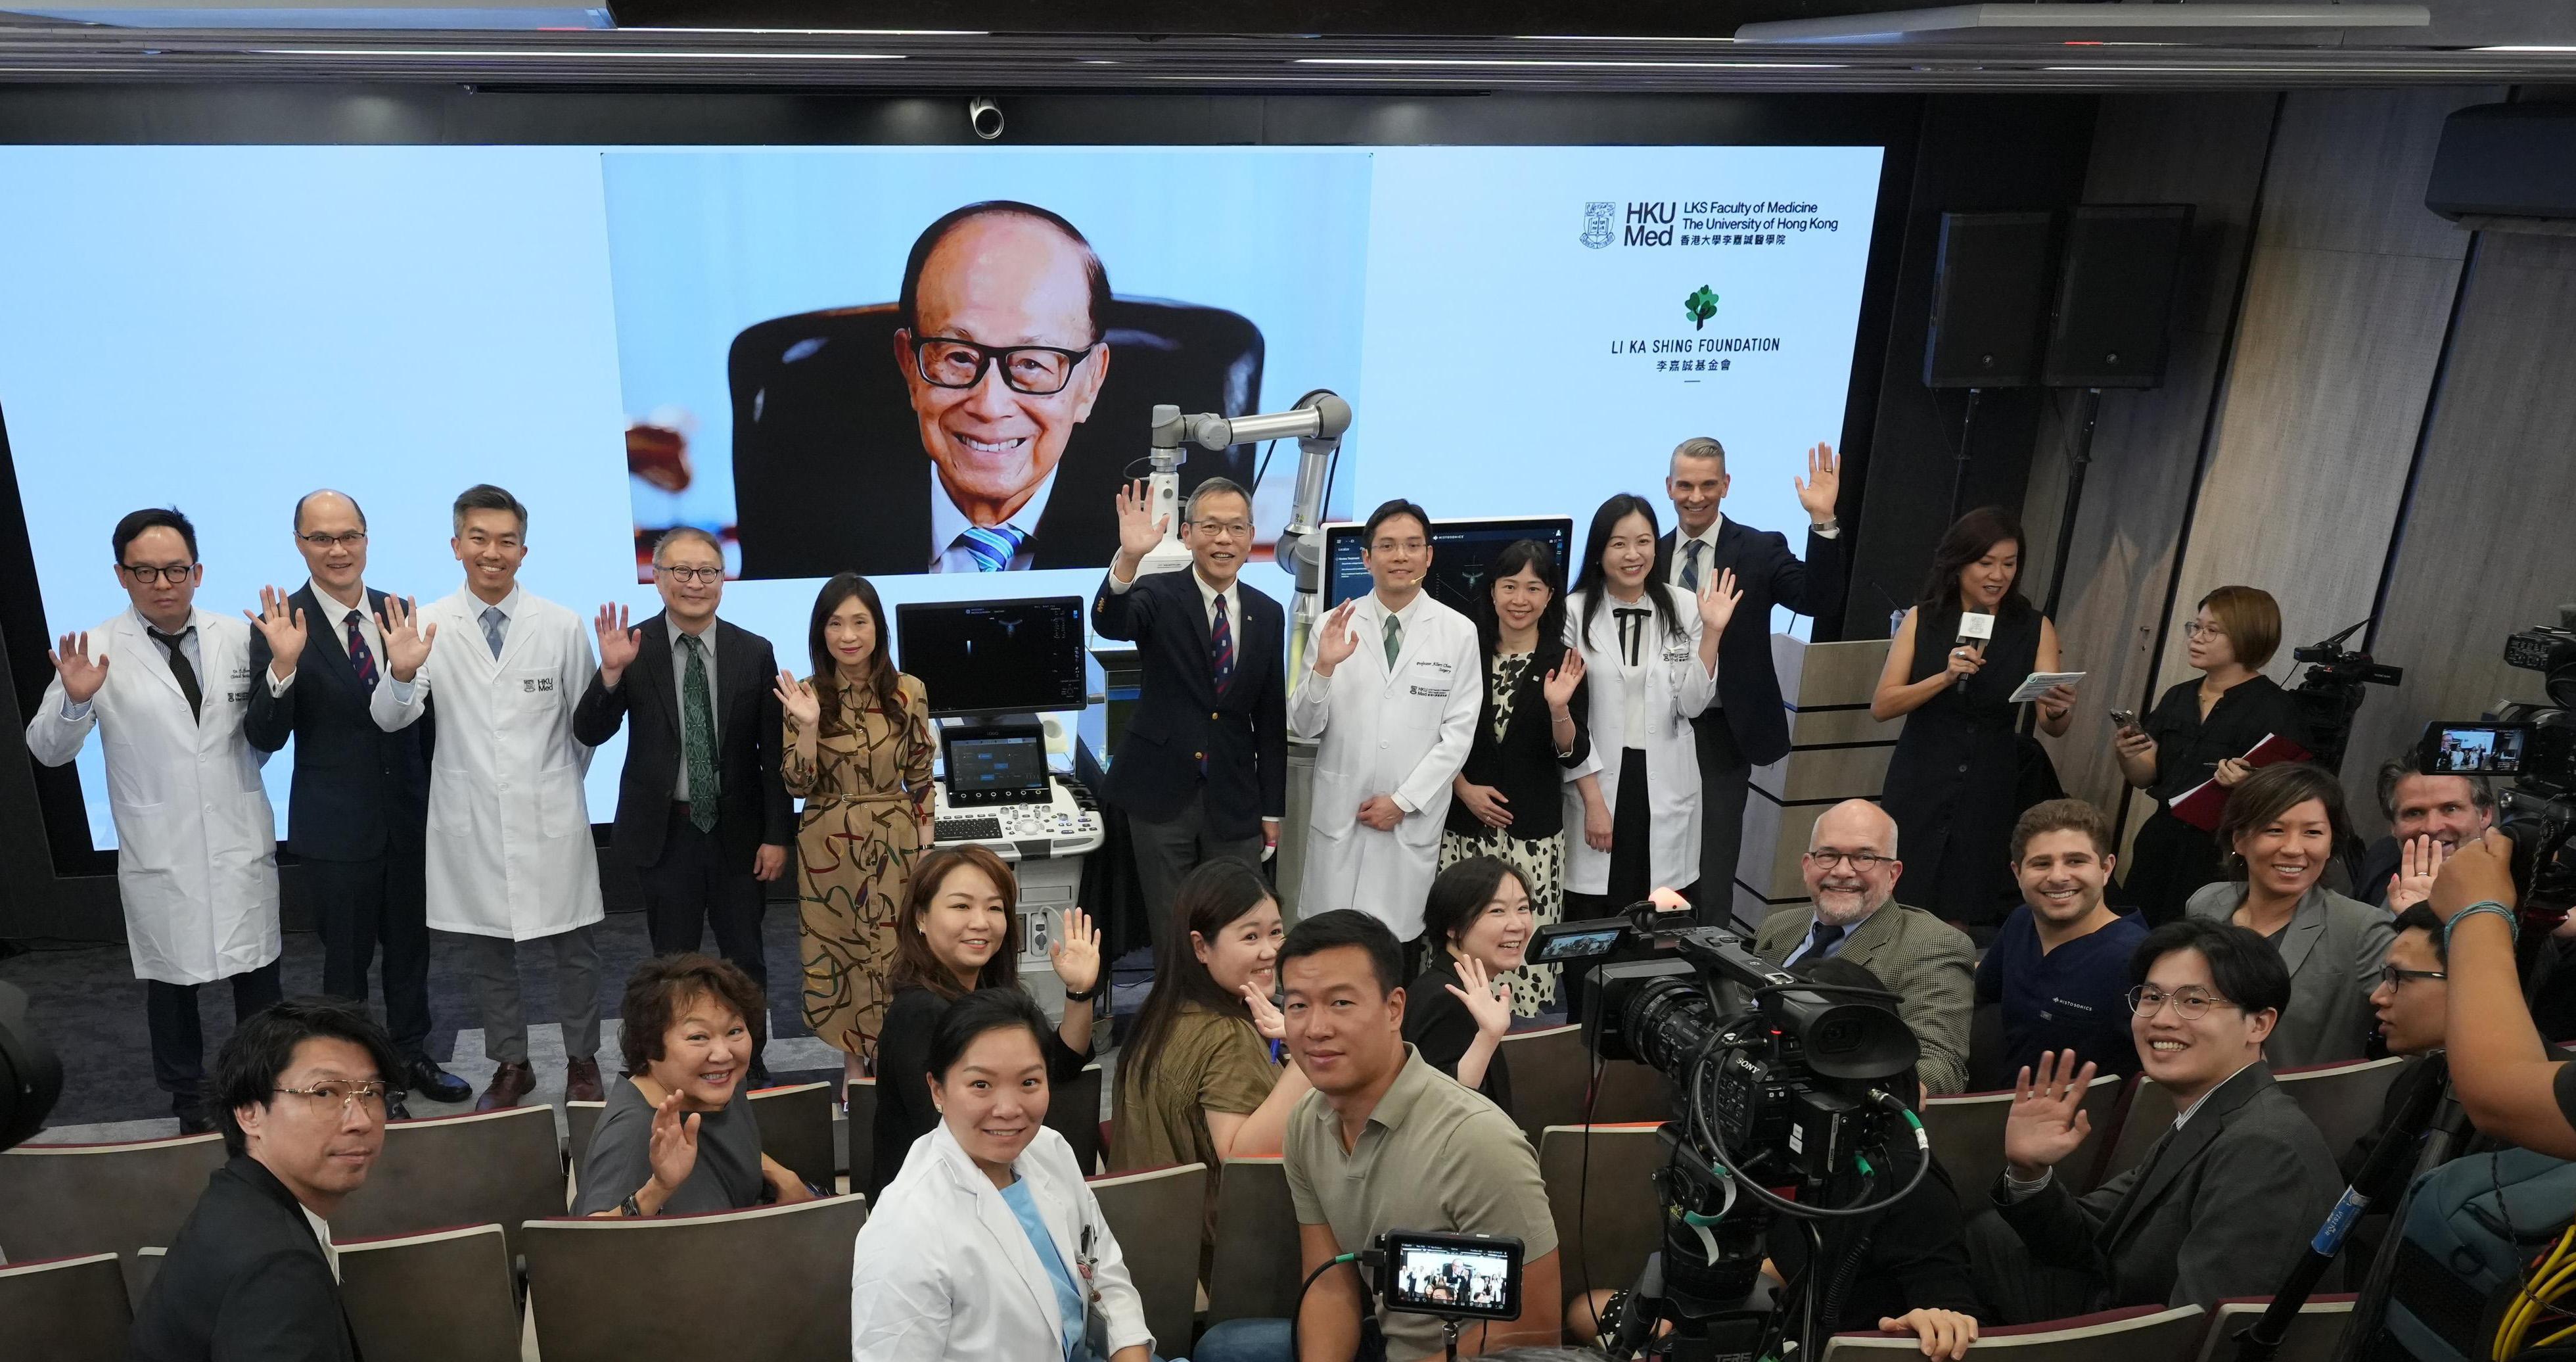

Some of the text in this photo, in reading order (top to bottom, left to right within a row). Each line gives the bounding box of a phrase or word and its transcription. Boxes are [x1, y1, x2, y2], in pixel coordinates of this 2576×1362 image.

[1626, 202, 1676, 224] HKU
[1684, 201, 1818, 216] LKS Faculty of Medicine
[1682, 217, 1838, 232] The University of Hong Kong
[1624, 225, 1674, 247] Med
[1680, 234, 1786, 246] 香港大學李嘉誠醫學院
[1611, 338, 1780, 354] LI KA SHING FOUNDATION
[1656, 359, 1731, 372] 李嘉誠基金會
[2059, 999, 2093, 1012] HISTOSONICS
[1736, 1057, 1761, 1074] SONY
